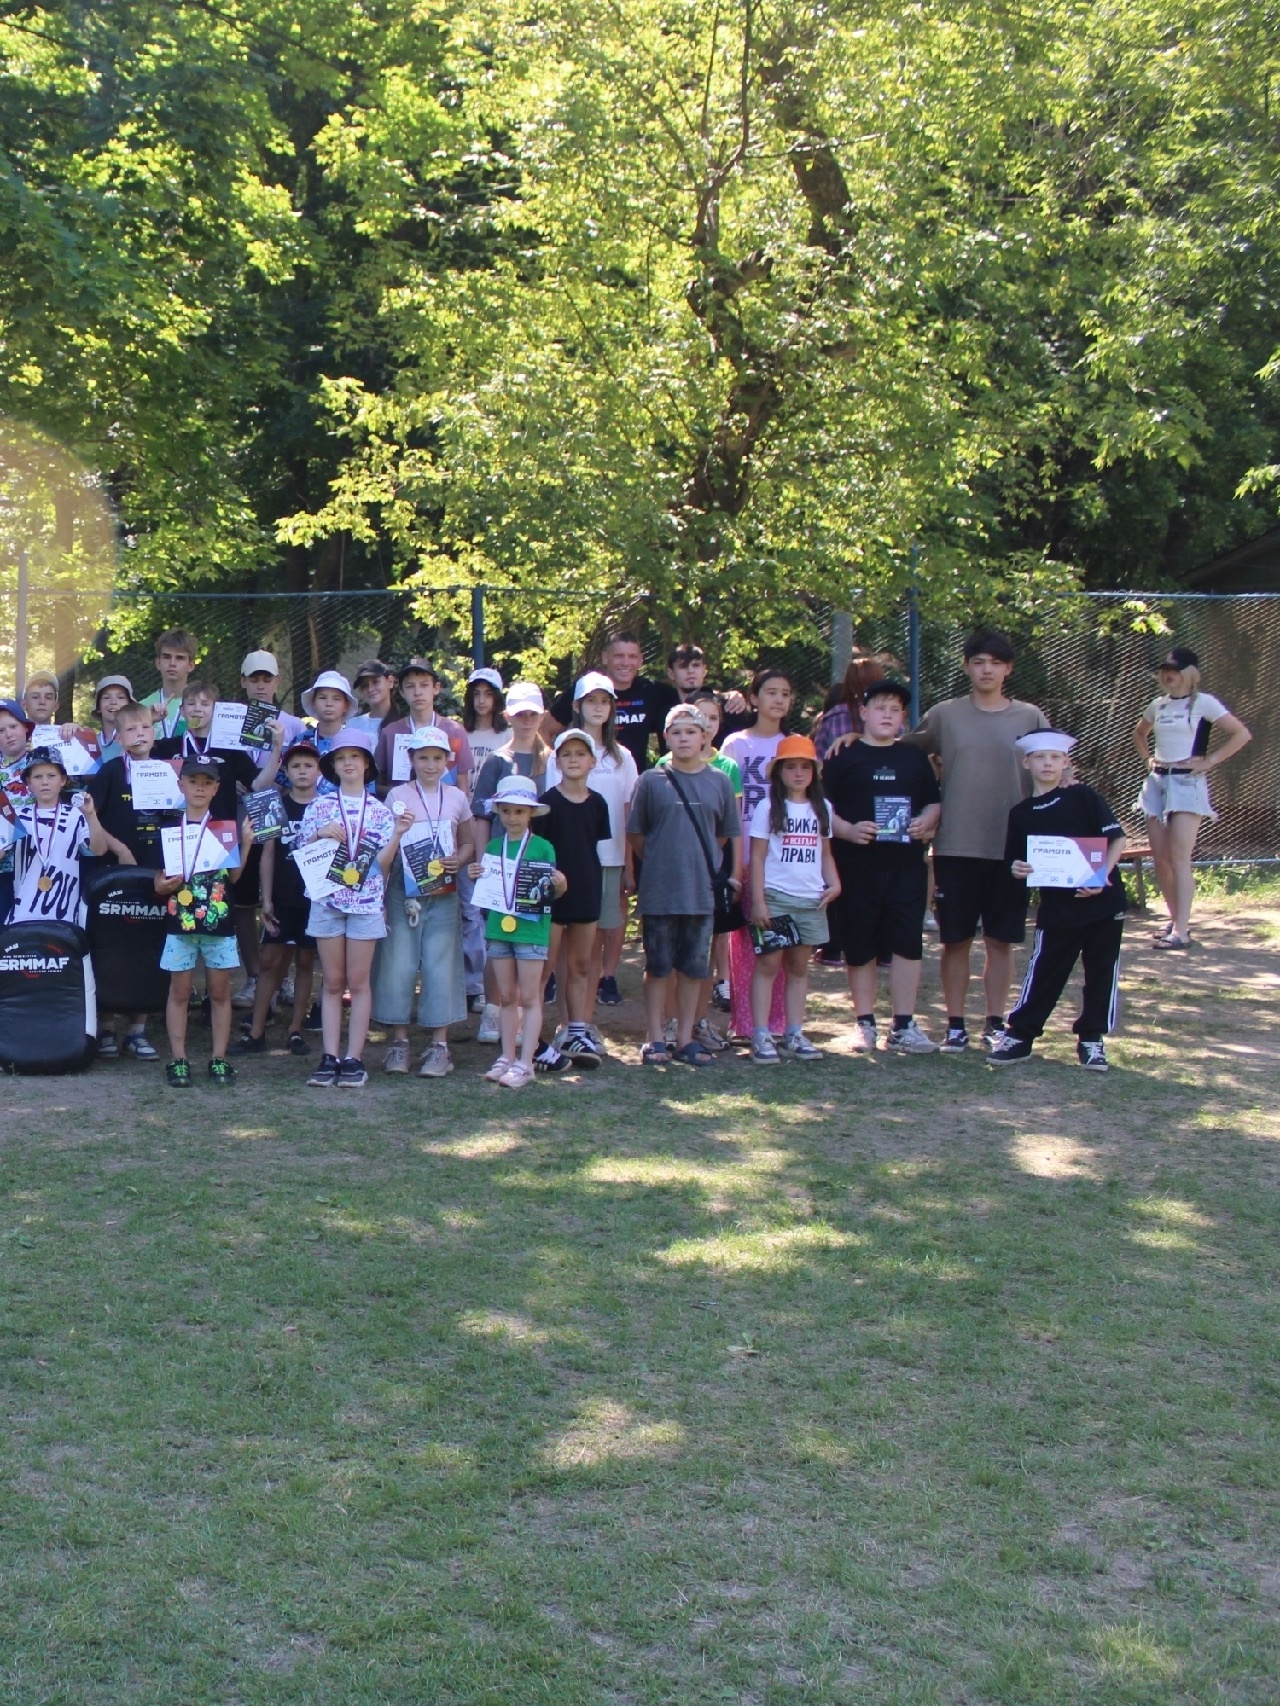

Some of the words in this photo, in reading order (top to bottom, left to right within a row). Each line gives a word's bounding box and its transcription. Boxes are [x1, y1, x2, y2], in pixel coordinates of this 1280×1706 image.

[787, 818, 818, 833] ВИКА
[780, 848, 816, 863] ПРАВА
[99, 903, 168, 916] SRMMAF
